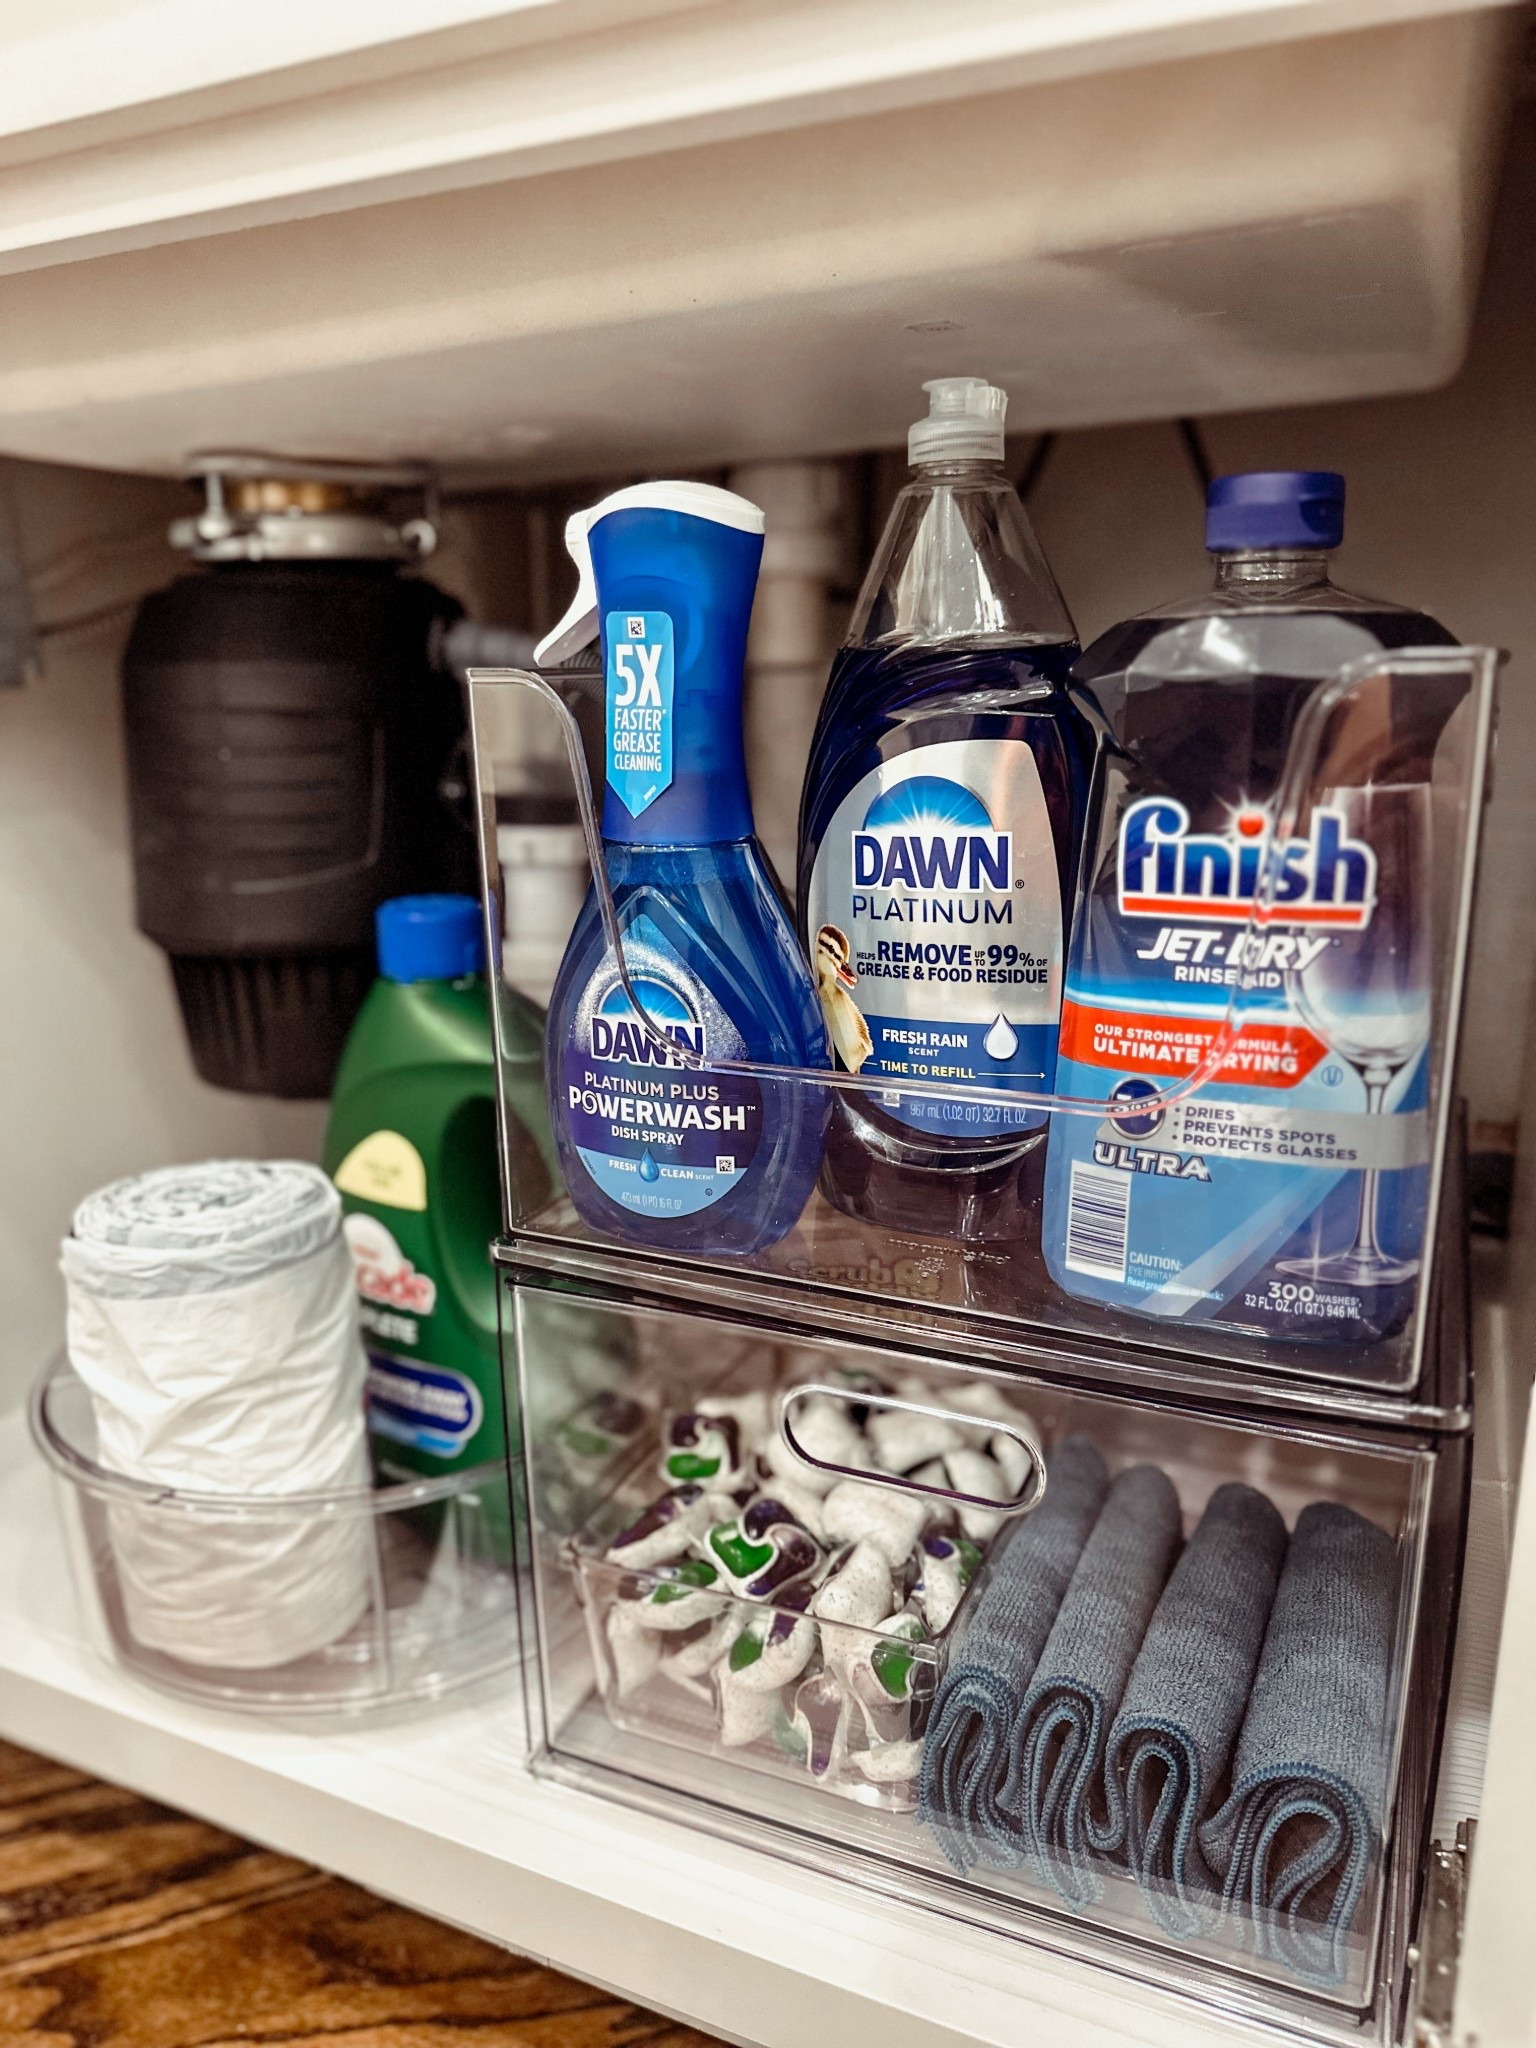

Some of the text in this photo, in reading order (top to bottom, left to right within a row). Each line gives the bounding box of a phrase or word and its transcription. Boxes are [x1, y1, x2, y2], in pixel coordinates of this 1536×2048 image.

[614, 643, 663, 707] 5X
[613, 731, 661, 754] GREASE
[614, 754, 662, 772] CLEANING
[1120, 799, 1372, 905] finish
[852, 895, 1012, 924] PLATINUM
[856, 951, 875, 961] HELPS
[877, 940, 972, 966] REMOVE
[974, 958, 986, 967] TO
[987, 944, 1034, 967] 99%
[1036, 958, 1048, 967] OF
[856, 961, 1048, 984] GREASE & FOOD RESIDUE
[1174, 965, 1237, 985] RINSE
[882, 1028, 968, 1048] FRESH RAIN
[1094, 1023, 1123, 1037] OUR
[1126, 1027, 1213, 1046] STRONGEST
[908, 1047, 939, 1057] SCENT
[1093, 1036, 1200, 1065] ULTIMATE
[880, 1060, 976, 1079] TIME TO REFILL
[584, 1071, 720, 1102] PLATINUM PLUS
[909, 1102, 925, 1117] 967
[982, 1106, 1000, 1123] 32.7
[1003, 1108, 1012, 1124] FL
[1185, 1106, 1235, 1121] DRIES
[611, 1125, 685, 1146] DISH SPRAY
[1183, 1119, 1336, 1145] PREVENTS SPOTS
[1182, 1133, 1357, 1161] PROTECTS GLASSES
[608, 1159, 637, 1172] FRESH
[660, 1168, 694, 1180] CLEAN
[1093, 1140, 1212, 1182] ULTRA
[1128, 1265, 1142, 1276] EYE
[1129, 1251, 1183, 1272] CAUTION:
[1127, 1276, 1146, 1289] Read
[1267, 1281, 1315, 1302] 300
[1244, 1293, 1257, 1307] 32
[1258, 1296, 1273, 1311] FL.
[1275, 1299, 1292, 1313] OZ.
[1326, 1305, 1346, 1319] 946
[1347, 1306, 1361, 1319] ML
